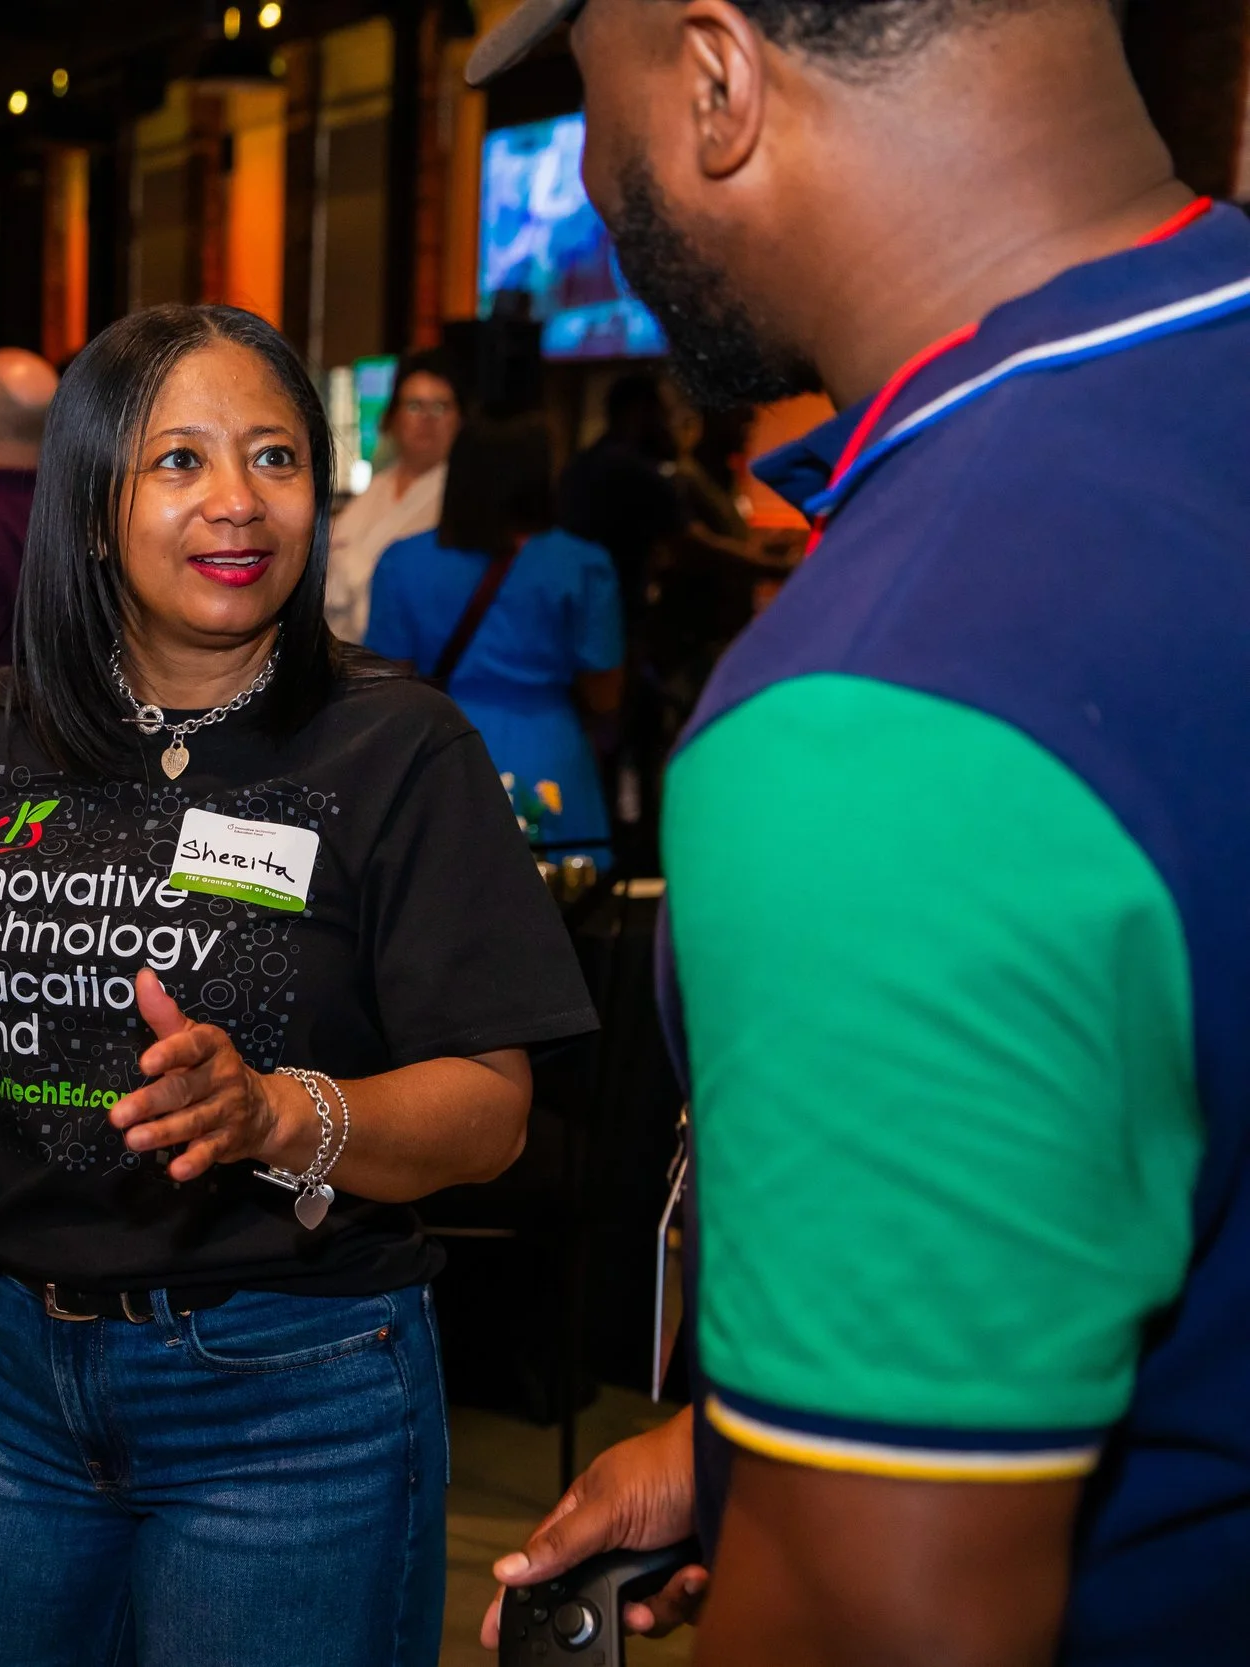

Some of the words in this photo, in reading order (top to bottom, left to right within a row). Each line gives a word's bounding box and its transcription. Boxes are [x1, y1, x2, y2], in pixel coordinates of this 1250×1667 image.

[201, 876, 234, 888] Grantee,
[236, 882, 253, 891] Past
[254, 886, 263, 894] or
[264, 888, 292, 902] Present
